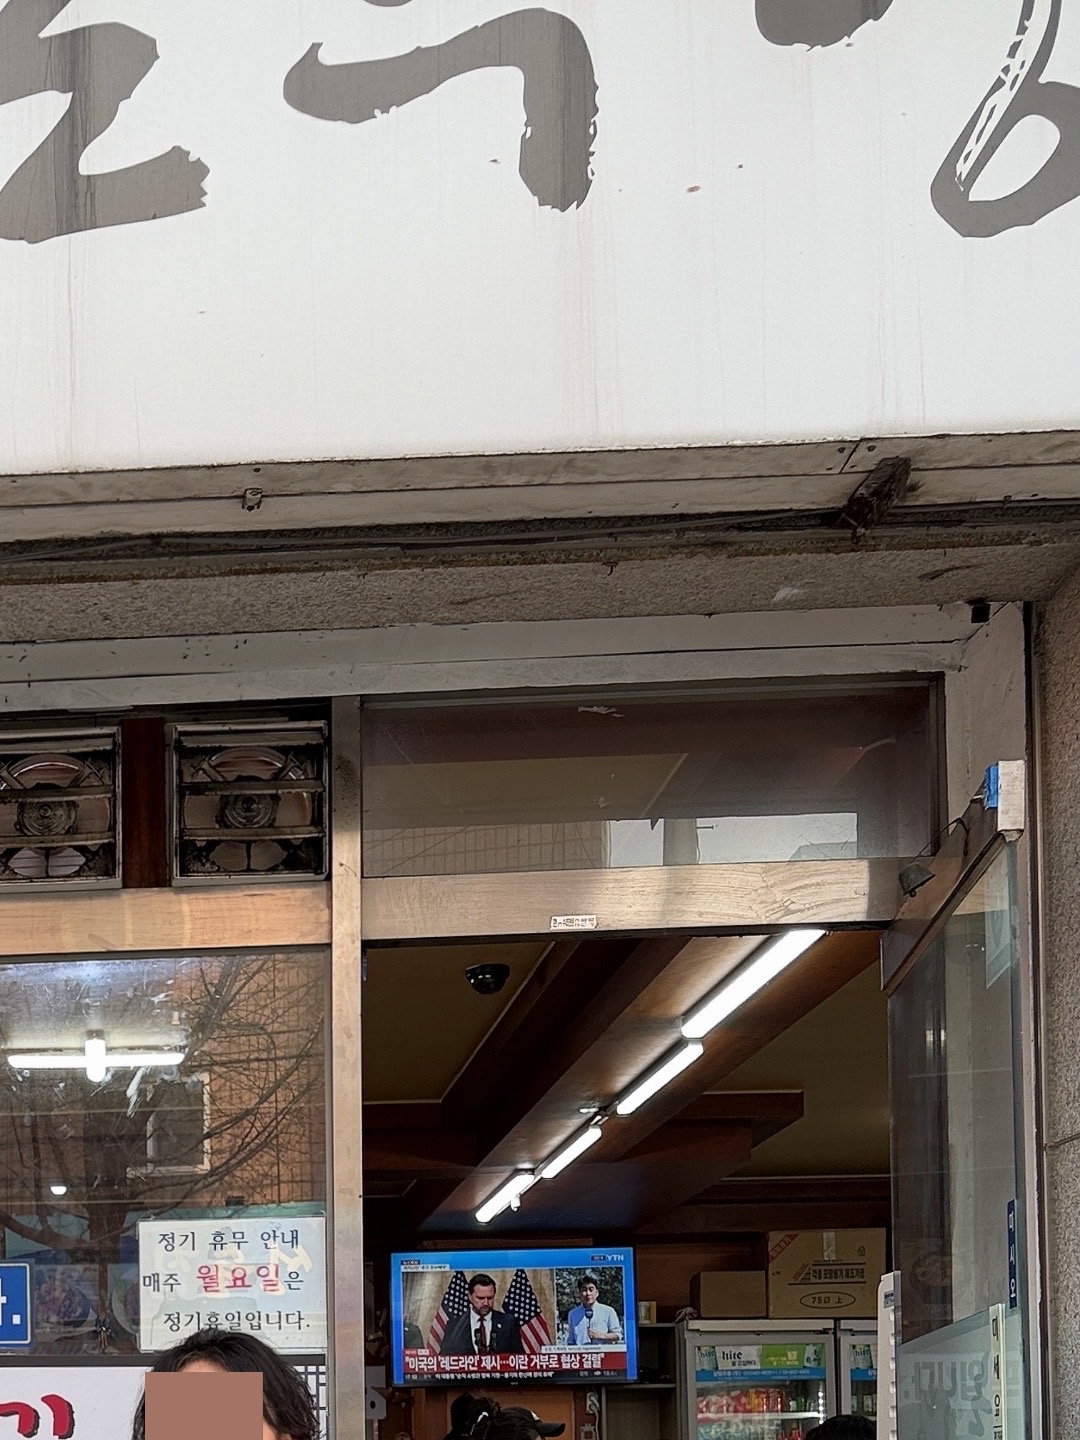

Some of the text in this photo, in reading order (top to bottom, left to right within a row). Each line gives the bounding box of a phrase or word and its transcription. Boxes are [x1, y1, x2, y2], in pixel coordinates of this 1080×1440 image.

[158, 1227, 299, 1252] 정기 휴무 안내
[142, 1264, 304, 1294] 매주 월요일은
[163, 1310, 311, 1333] 정기휴일입니다.
[530, 1354, 559, 1370] 거부로
[561, 1353, 580, 1369] 협상
[721, 1350, 743, 1361] hite
